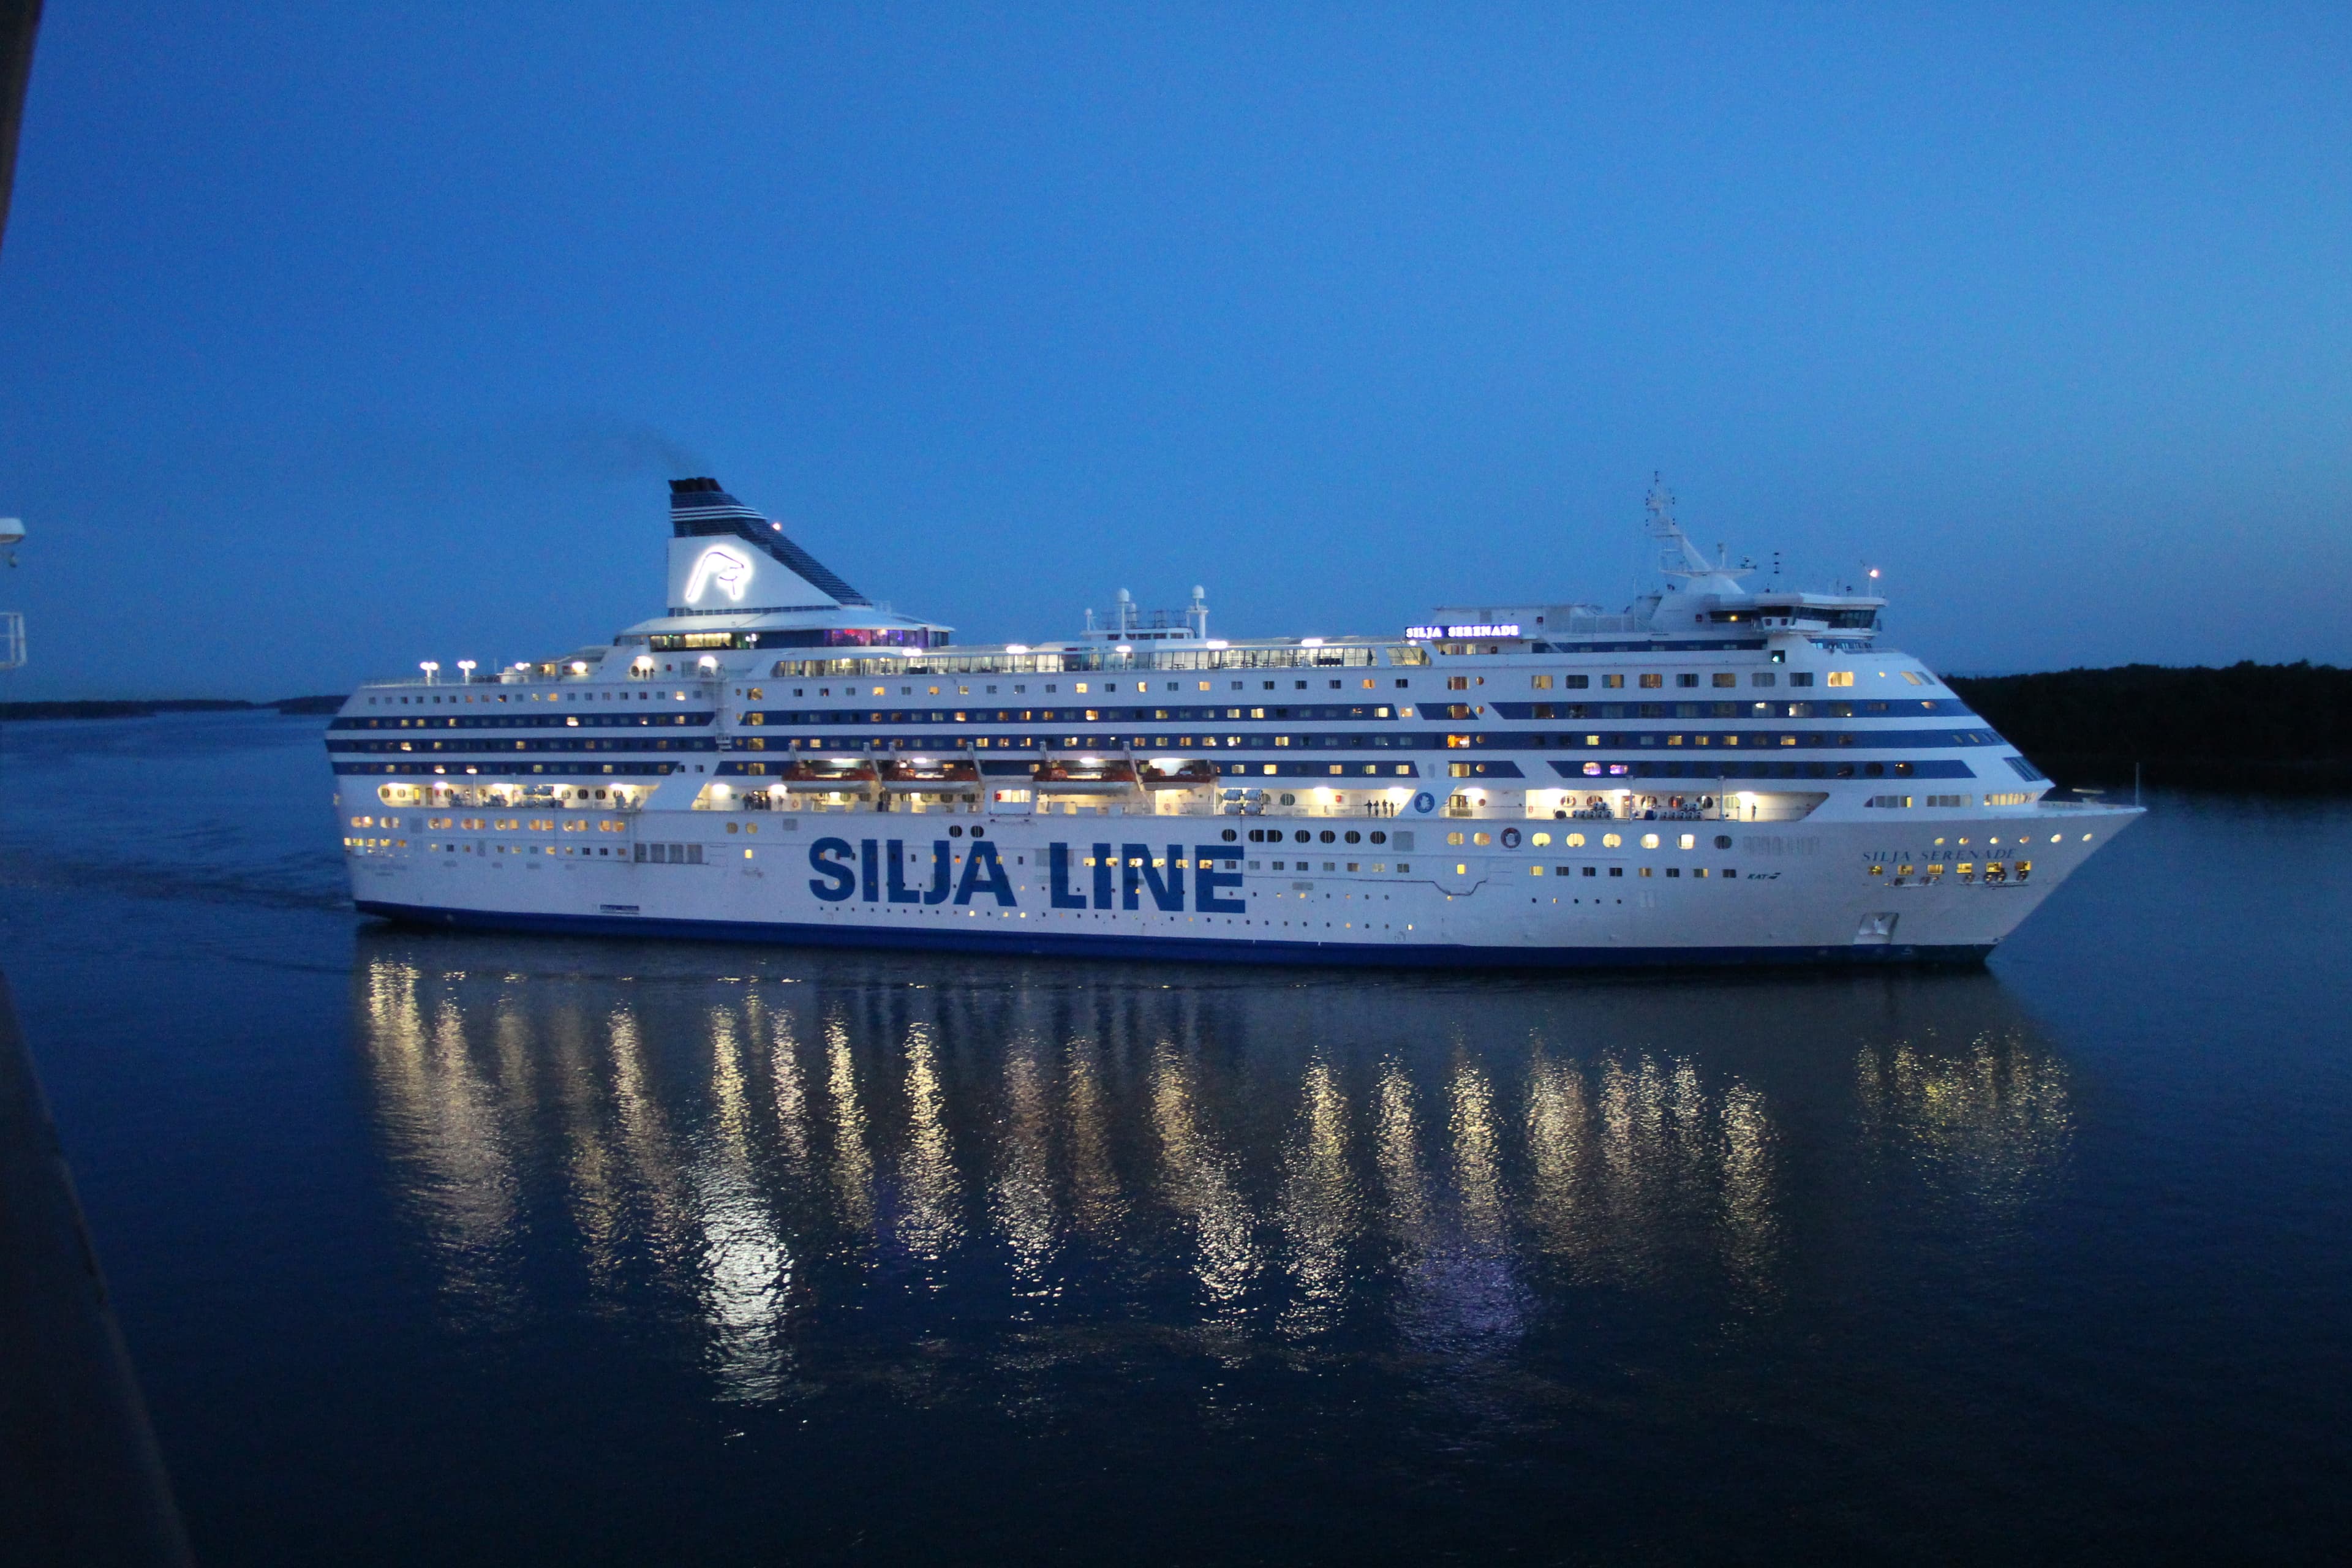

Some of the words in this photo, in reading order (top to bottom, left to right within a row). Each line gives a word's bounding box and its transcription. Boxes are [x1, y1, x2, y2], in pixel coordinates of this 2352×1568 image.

[1406, 627, 1442, 639] SILJA
[1447, 625, 1519, 638] SERENADE
[1863, 851, 1910, 863] SILJA
[1921, 848, 2016, 861] SERENADE
[809, 837, 1018, 907] SILJA
[1049, 842, 1246, 913] LINE
